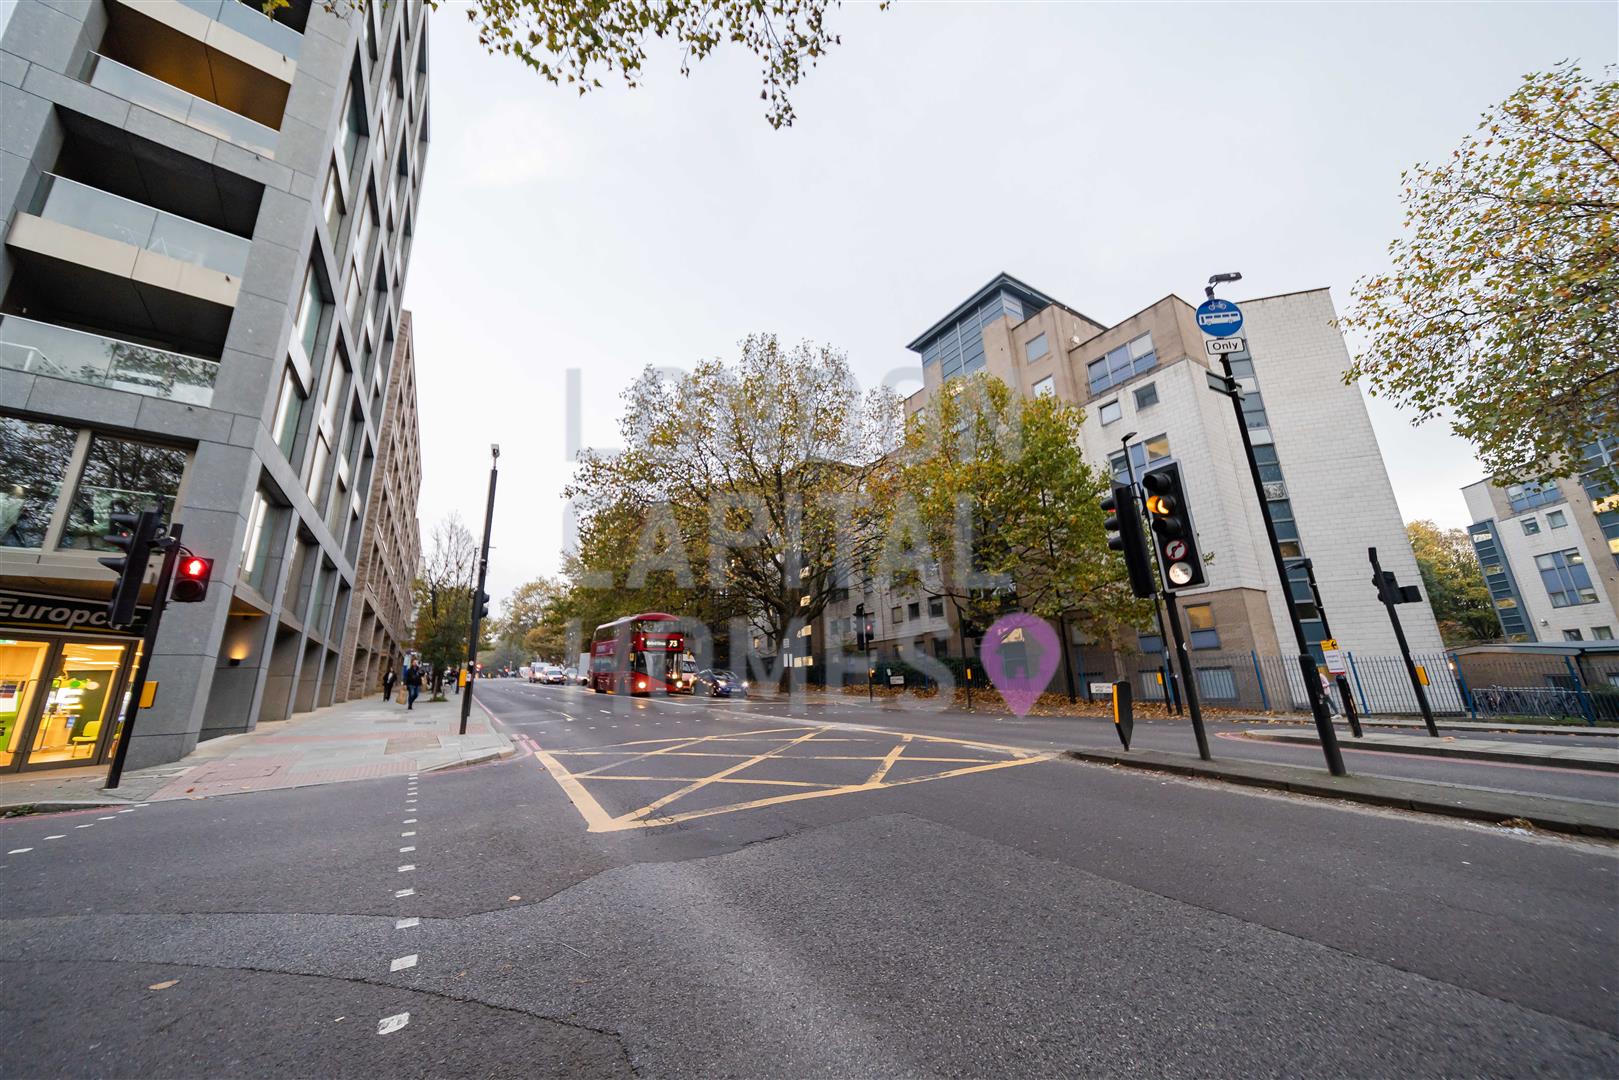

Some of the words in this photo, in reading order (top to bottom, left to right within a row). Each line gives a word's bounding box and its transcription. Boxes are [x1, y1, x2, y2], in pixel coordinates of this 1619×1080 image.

[1212, 341, 1238, 351] Only
[0, 597, 141, 631] Europcr
[669, 640, 678, 648] 73
